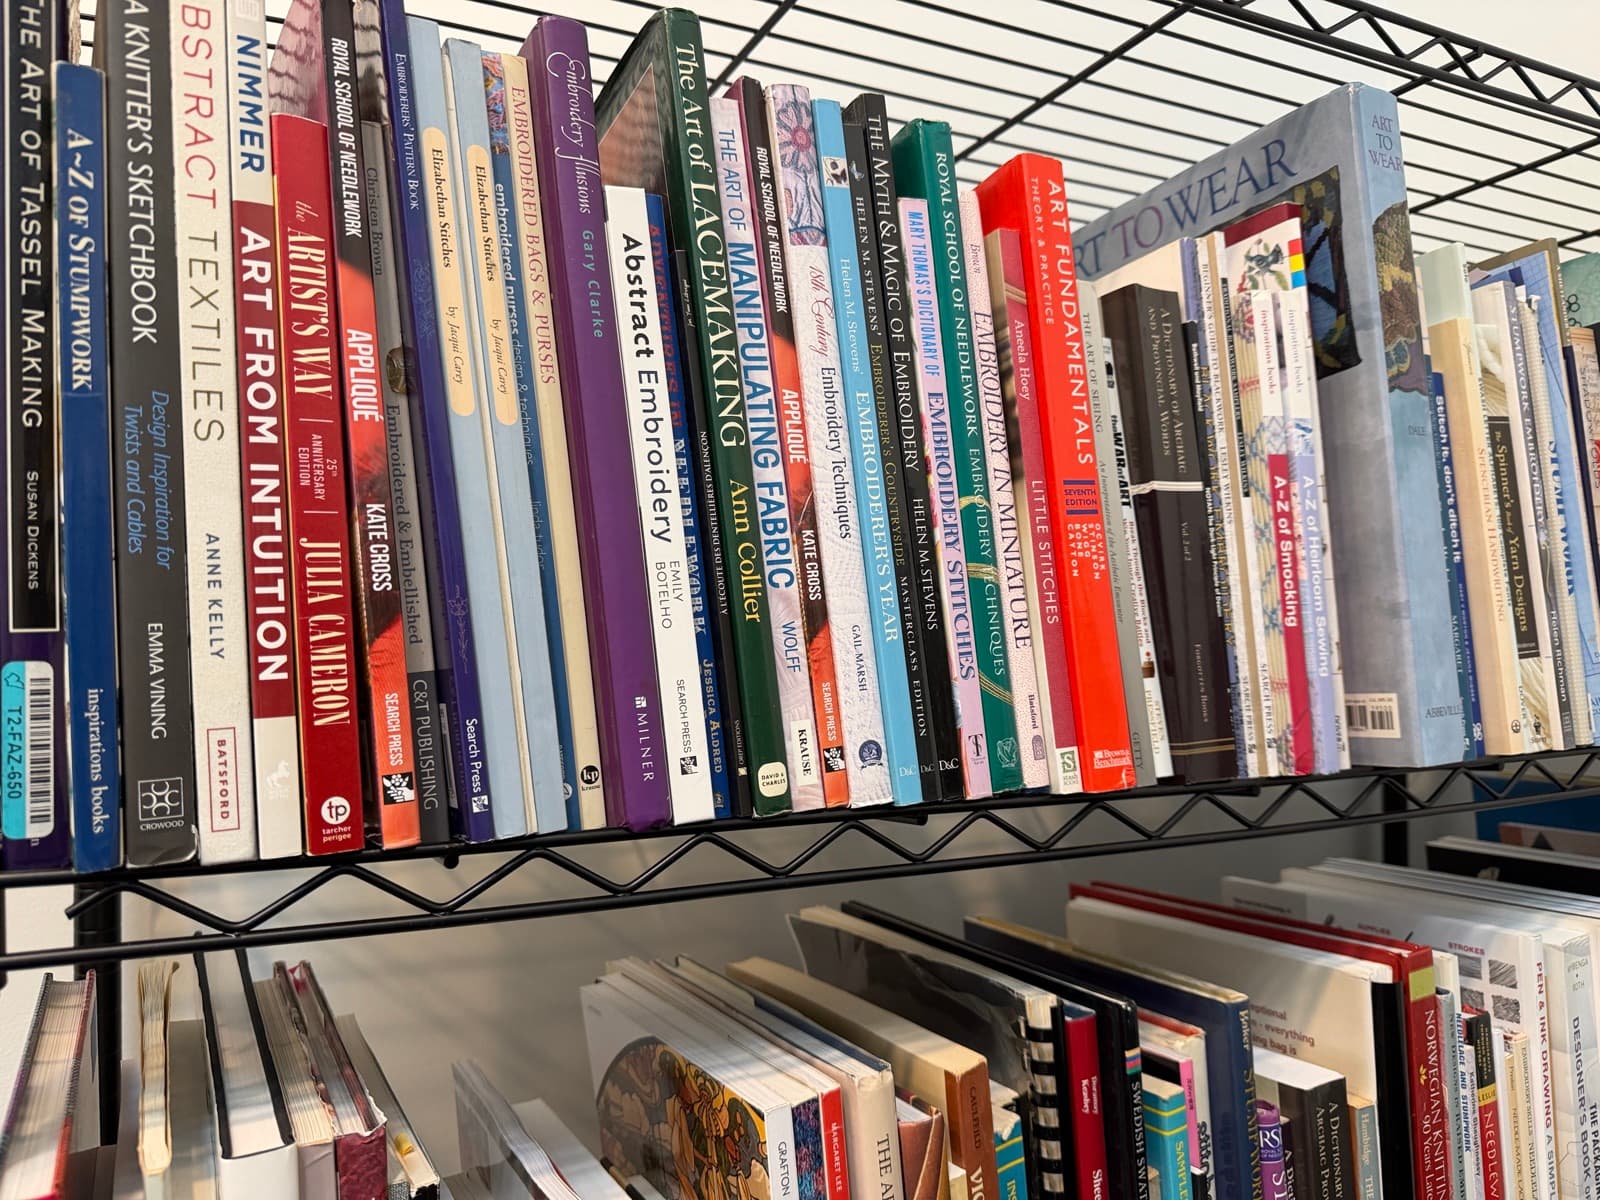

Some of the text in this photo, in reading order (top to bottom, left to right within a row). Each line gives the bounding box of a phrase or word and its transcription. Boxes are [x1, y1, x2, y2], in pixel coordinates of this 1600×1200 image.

[237, 34, 265, 172] NIMMER
[331, 38, 362, 238] ROYAL SCHOOL OF NEEDLEWORK
[395, 53, 419, 210] EMBROIDERERS' PATTERN BOOK
[545, 52, 600, 214] Embroidery Illusions
[1369, 150, 1403, 171] WEAR
[1372, 115, 1393, 132] ART
[1376, 134, 1393, 151] TO
[124, 0, 157, 343] A KNITTER'S SKETCHBOOK
[431, 148, 451, 268] Elizabethan Stitches
[1112, 139, 1297, 260] TO WEAR
[20, 57, 45, 429] ART OF TASSEL MAKING
[512, 86, 556, 385] EMBROIDERED BAGS PURSES
[582, 230, 603, 338] Gary Clarke
[675, 42, 745, 447] The Art of LACEMAKING
[868, 115, 920, 472] THE MYTH & MAGIC OF EMBROIDERY
[1030, 176, 1055, 325] THEORY PRACTICE
[68, 233, 96, 391] STUMPWORK
[188, 230, 224, 441] TEXTILES
[287, 227, 333, 400] ARTIST'S WAY
[935, 152, 977, 438] ROYAL SCHOOL OF NEEDLEWORK
[1047, 179, 1094, 465] ART FUNDAMENTALS
[346, 329, 383, 422] APPLIQUÉ
[622, 233, 672, 543] Abstract Embroidery
[718, 129, 794, 589] THE ART OF MANIPULATING FABRIC
[1014, 320, 1031, 400] Aneela Hoey
[240, 227, 288, 681] ART FROM INTUITION
[299, 447, 311, 486] EDITION
[312, 433, 325, 501] ANNIVERSARY
[820, 368, 852, 540] Embroidery Techniques
[1436, 396, 1447, 443] Stitch
[26, 471, 39, 590] SUSAN DICKENS
[124, 405, 145, 554] Twists and Cables
[151, 390, 173, 570] Design Inspiration for
[855, 391, 899, 643] EMBROIDERER'S YEAR
[927, 391, 976, 680] EMBROIDERY STITCHES
[974, 311, 1032, 650] EMBROIDERY IN MINIATURE
[1064, 488, 1096, 497] SEVENTH
[1065, 498, 1097, 506] EDITION
[1443, 463, 1456, 505] don't
[1448, 507, 1459, 545] ditch
[1497, 443, 1527, 632] Spinner's Yarn Designs
[205, 533, 224, 660] ANNE KELLY
[366, 504, 392, 591] KATE CROSS
[656, 562, 672, 629] BOTELHO
[669, 561, 684, 602] EMILY
[729, 479, 761, 623] Ann Collier
[1031, 479, 1059, 625] LITTLE STITCHES
[1278, 518, 1297, 627] of Smocking
[1309, 535, 1328, 677] Heirloom Sewing
[148, 622, 167, 740] EMMA VINING
[299, 538, 351, 726] JULIA CAMERON
[782, 620, 801, 673] WOLFF
[851, 625, 867, 692] GAIL MARSH
[1551, 610, 1566, 702] Helen Richman
[6, 705, 23, 800] T2-FAZ-650
[87, 689, 109, 834] inspirations books
[385, 693, 402, 766] SEARCH PRESS
[409, 680, 438, 811] C&T PUBLISHING
[466, 718, 482, 794] Search Press
[637, 714, 653, 782] MILNER
[703, 659, 722, 774] JESSICA ALDRED
[797, 729, 811, 776] KRAUSE
[939, 758, 959, 771] D&C
[140, 821, 184, 831] CROWOOD
[216, 739, 229, 820] BATSFORD
[322, 826, 351, 836] tarcher
[1448, 942, 1485, 955] STROKES
[1425, 1009, 1444, 1125] NORWEGIAN
[1537, 962, 1553, 1128] PEN INK DRAWING
[1572, 1015, 1592, 1181] DESIGNER'S BOOK
[777, 1140, 790, 1196] GRAFTON
[831, 1122, 841, 1171] MARGARET
[877, 1132, 893, 1176] THE
[1132, 1081, 1145, 1153] SWEDISH
[1461, 1095, 1470, 1153] STUMPWORK
